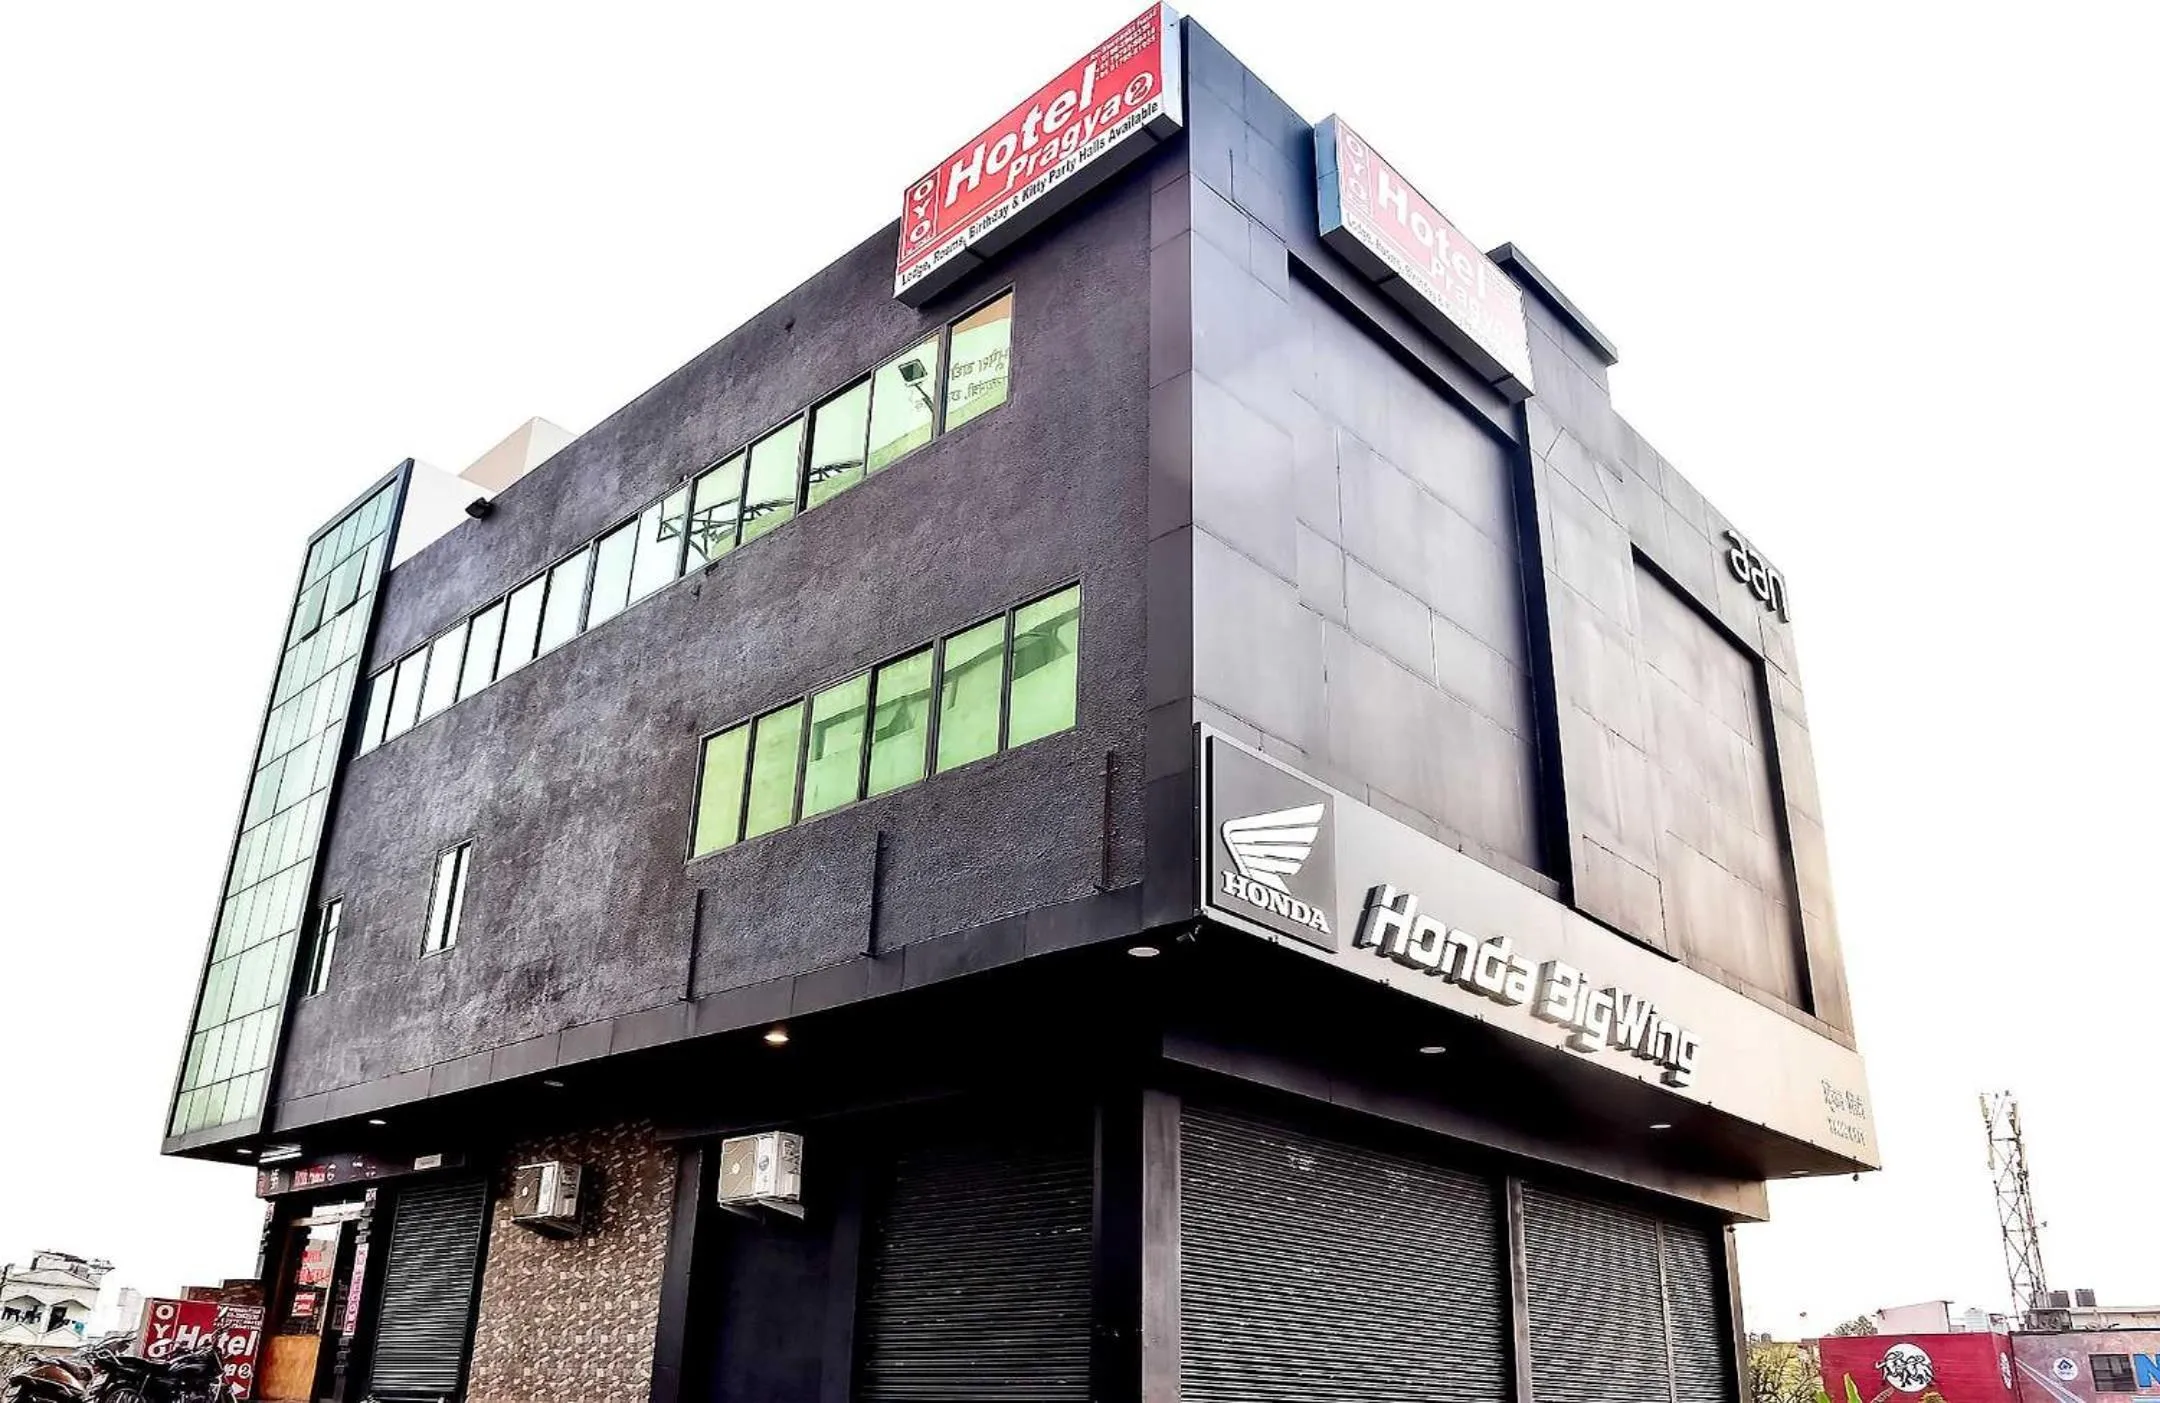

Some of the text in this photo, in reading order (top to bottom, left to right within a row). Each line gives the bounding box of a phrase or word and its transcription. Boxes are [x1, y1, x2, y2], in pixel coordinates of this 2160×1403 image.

[944, 60, 1098, 208] Hotel
[968, 204, 1009, 240] Birthday
[1011, 195, 1020, 209] &
[1022, 178, 1047, 203] Kitty
[1049, 157, 1076, 184] Party
[1079, 138, 1106, 163] Halls
[1108, 101, 1158, 143] Available
[1003, 94, 1121, 191] Pragya
[909, 180, 934, 243] OYO
[1378, 170, 1487, 299] Hotel
[1221, 870, 1331, 934] HONDA
[1353, 884, 1699, 1088] Honda BigWing
[148, 1304, 174, 1358] OYO
